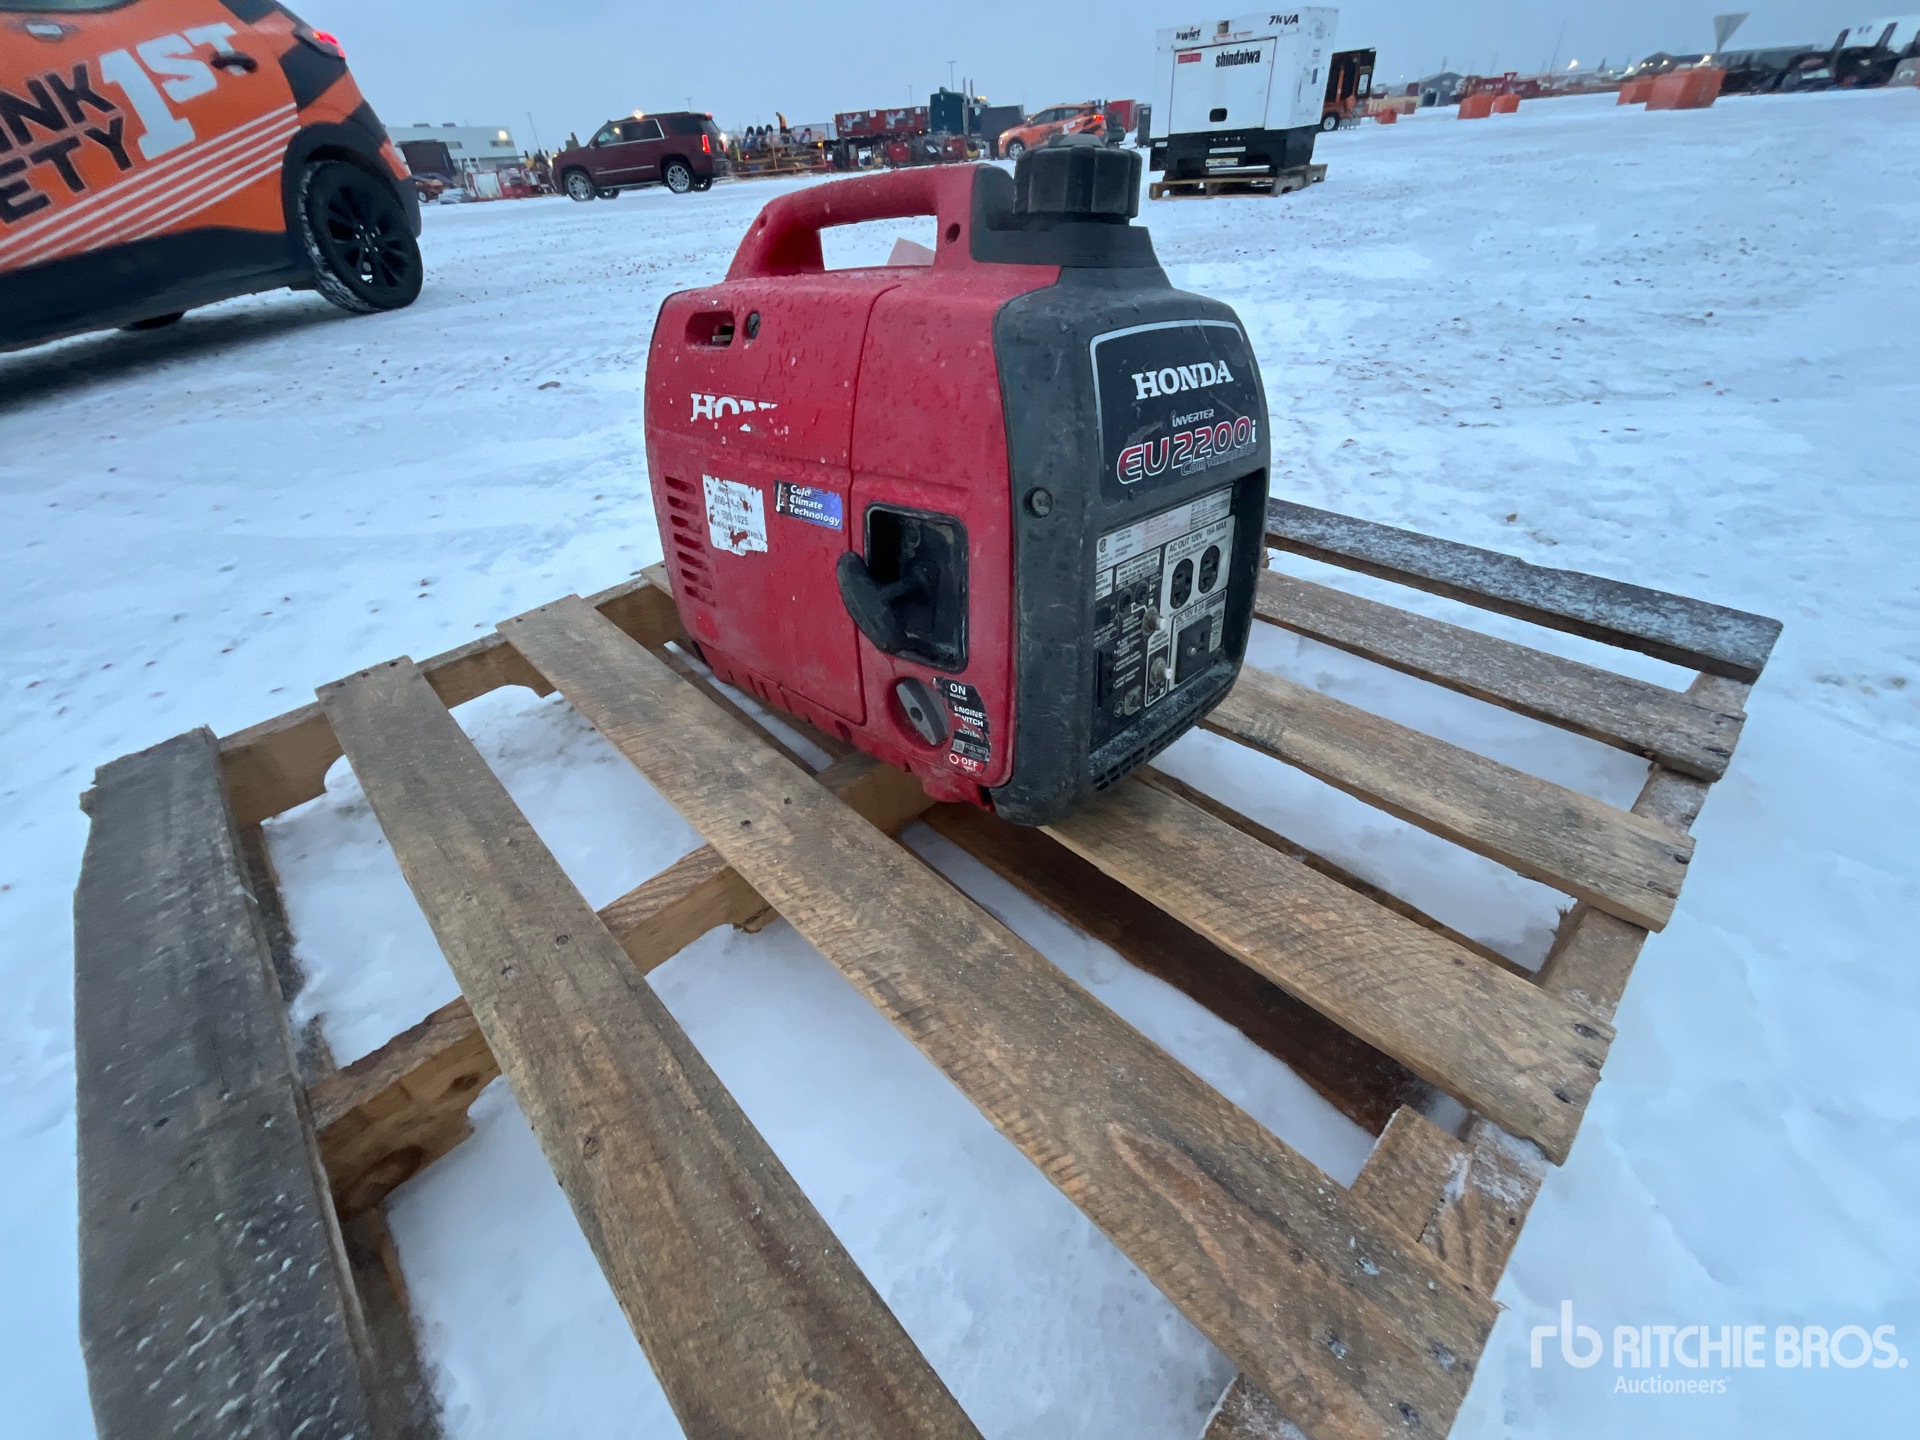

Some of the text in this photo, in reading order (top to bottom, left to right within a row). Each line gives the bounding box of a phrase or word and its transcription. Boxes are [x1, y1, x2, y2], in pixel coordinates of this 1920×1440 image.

[1215, 49, 1261, 67] shindaiwa
[100, 22, 240, 161] 1ST
[1131, 360, 1234, 400] HONDA
[1116, 416, 1257, 485] EU2200i
[790, 484, 811, 497] Cold
[789, 494, 823, 510] Climate
[789, 504, 841, 527] Technology
[949, 682, 966, 697] ON
[954, 705, 983, 719] ENGINE
[961, 757, 978, 768] OFF
